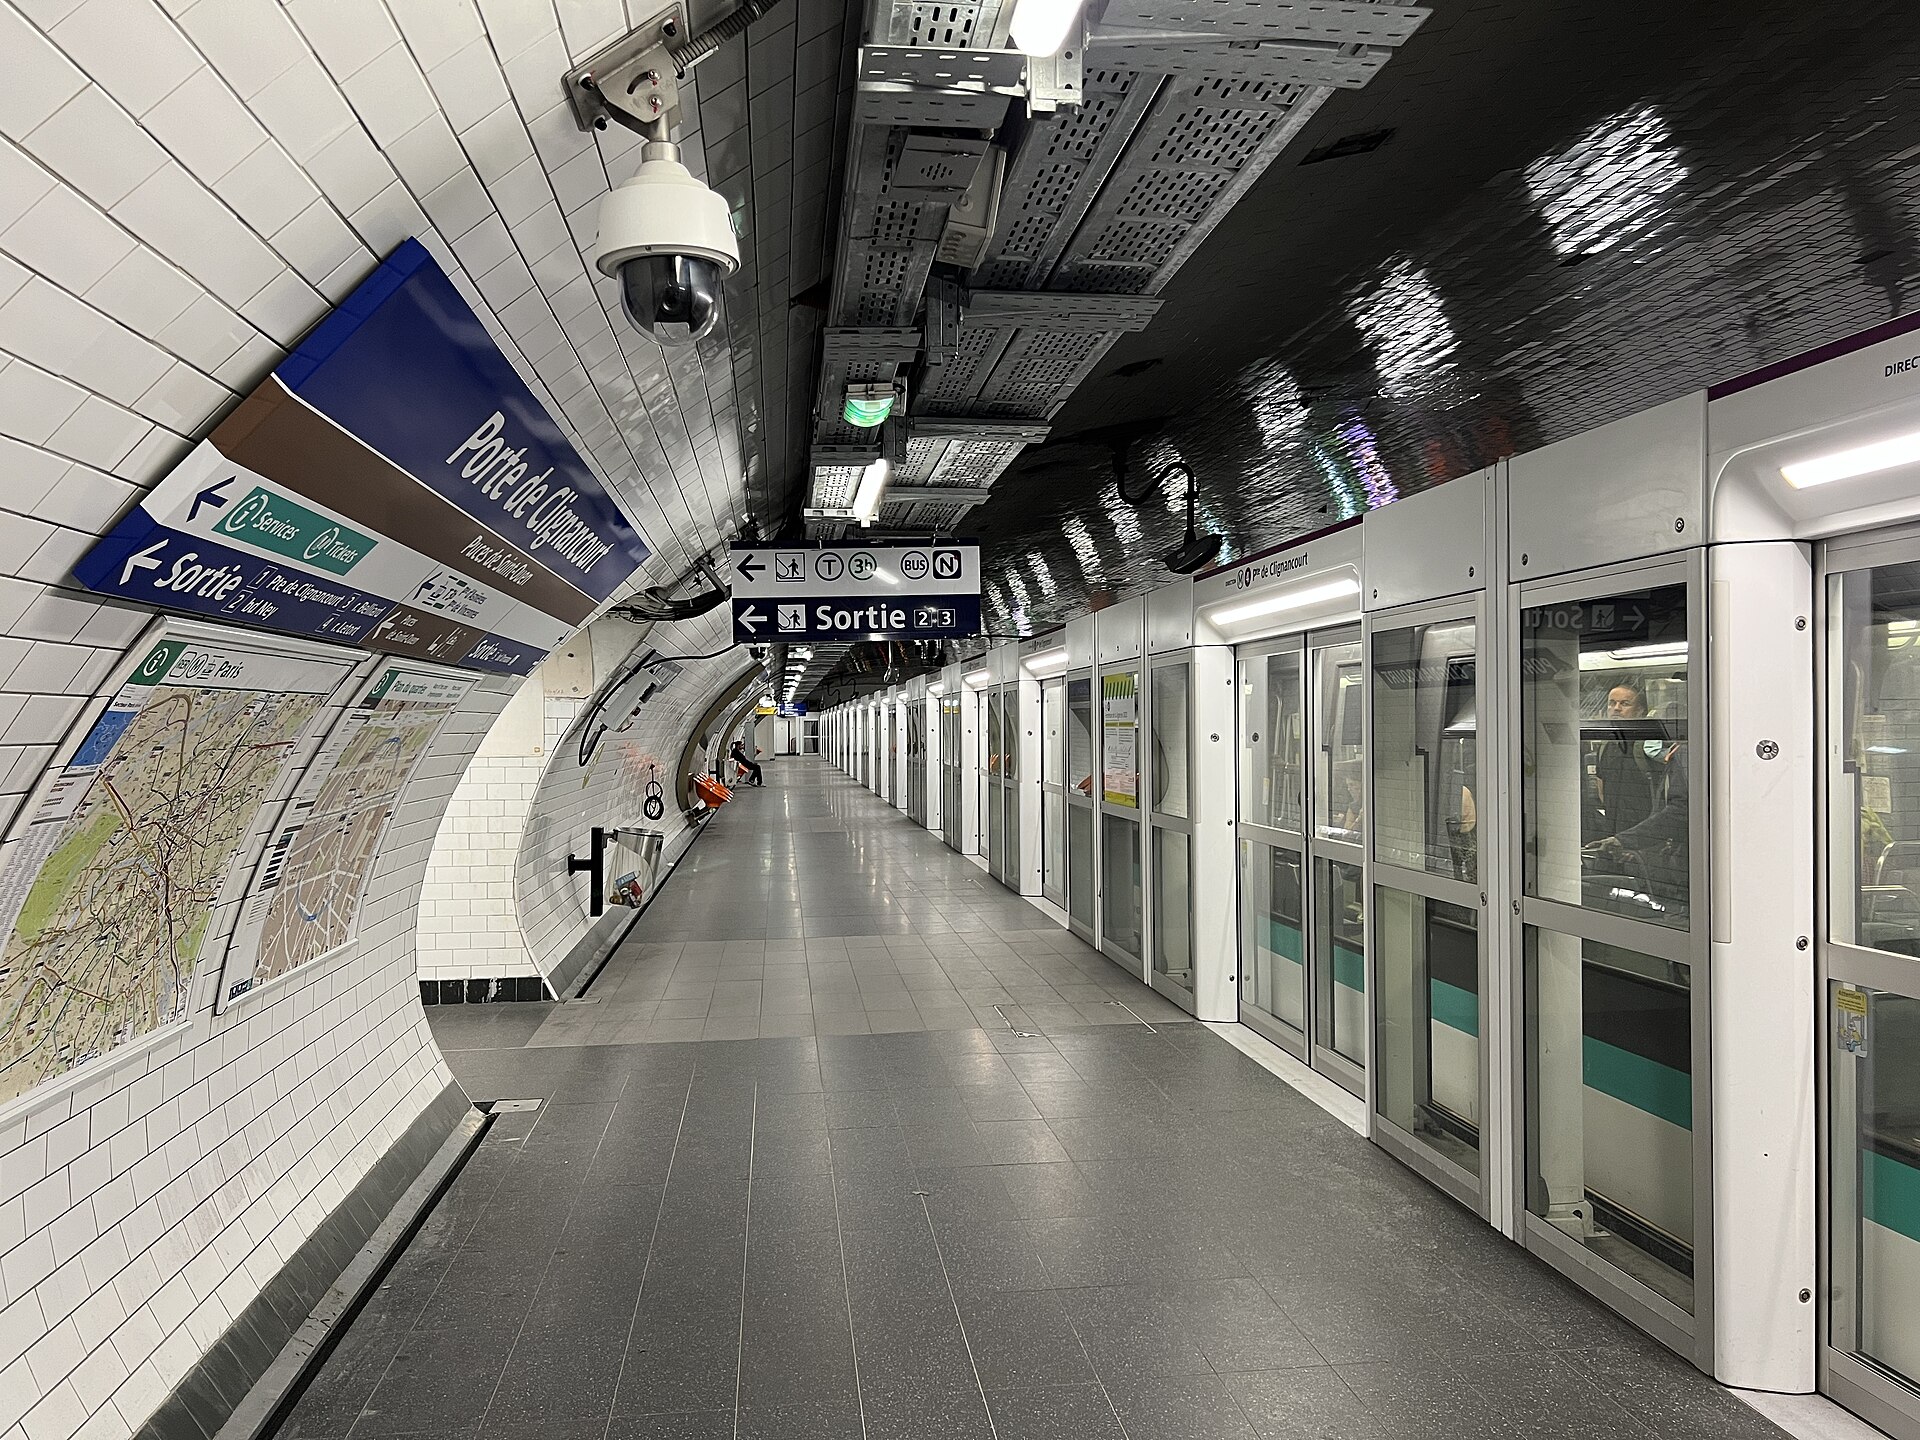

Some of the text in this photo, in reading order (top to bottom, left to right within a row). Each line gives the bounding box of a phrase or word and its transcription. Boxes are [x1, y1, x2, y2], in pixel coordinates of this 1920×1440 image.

[445, 411, 615, 573] Porte de Clignancourt
[253, 512, 300, 541] Services
[326, 540, 358, 564] Tickets
[460, 535, 534, 586] Puces de Saint-Ouen
[904, 559, 926, 571] BUS
[1261, 565, 1268, 579] de
[1269, 552, 1309, 577] Clignancourt
[154, 553, 243, 600] Sortie
[255, 571, 345, 608] 1 Pte de Clignancourt
[228, 594, 279, 620] 2 bd Ney
[342, 596, 355, 609] 3
[322, 617, 334, 629] 4
[816, 603, 952, 630] Sortie 2 3
[468, 640, 500, 661] Sortie
[214, 661, 244, 679] Paris
